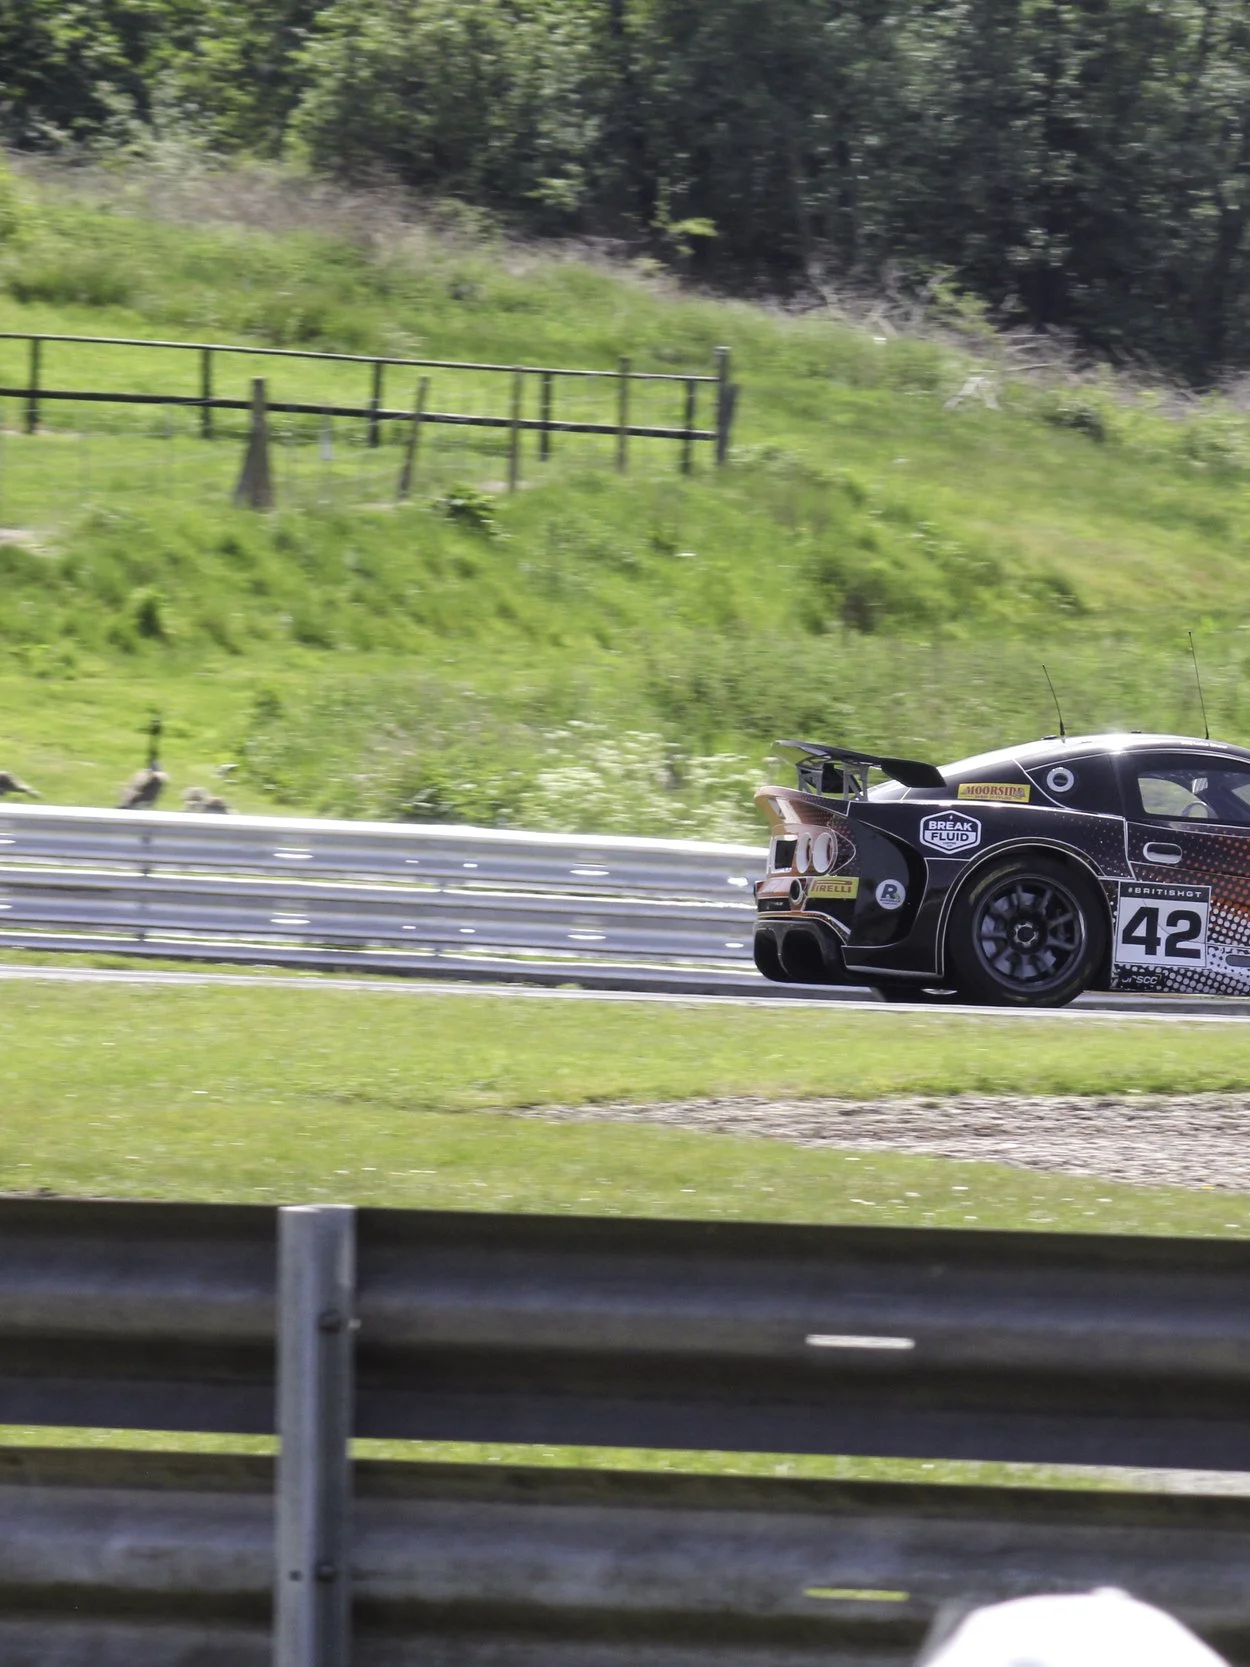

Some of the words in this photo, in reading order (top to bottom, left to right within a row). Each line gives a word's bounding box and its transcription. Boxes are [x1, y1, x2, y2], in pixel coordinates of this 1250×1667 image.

[928, 820, 973, 831] BREAK
[931, 832, 969, 842] FLUID
[811, 880, 853, 893] PIRELLI
[881, 884, 898, 899] R
[1128, 887, 1202, 898] #BRITISHGT
[1122, 906, 1202, 959] 42
